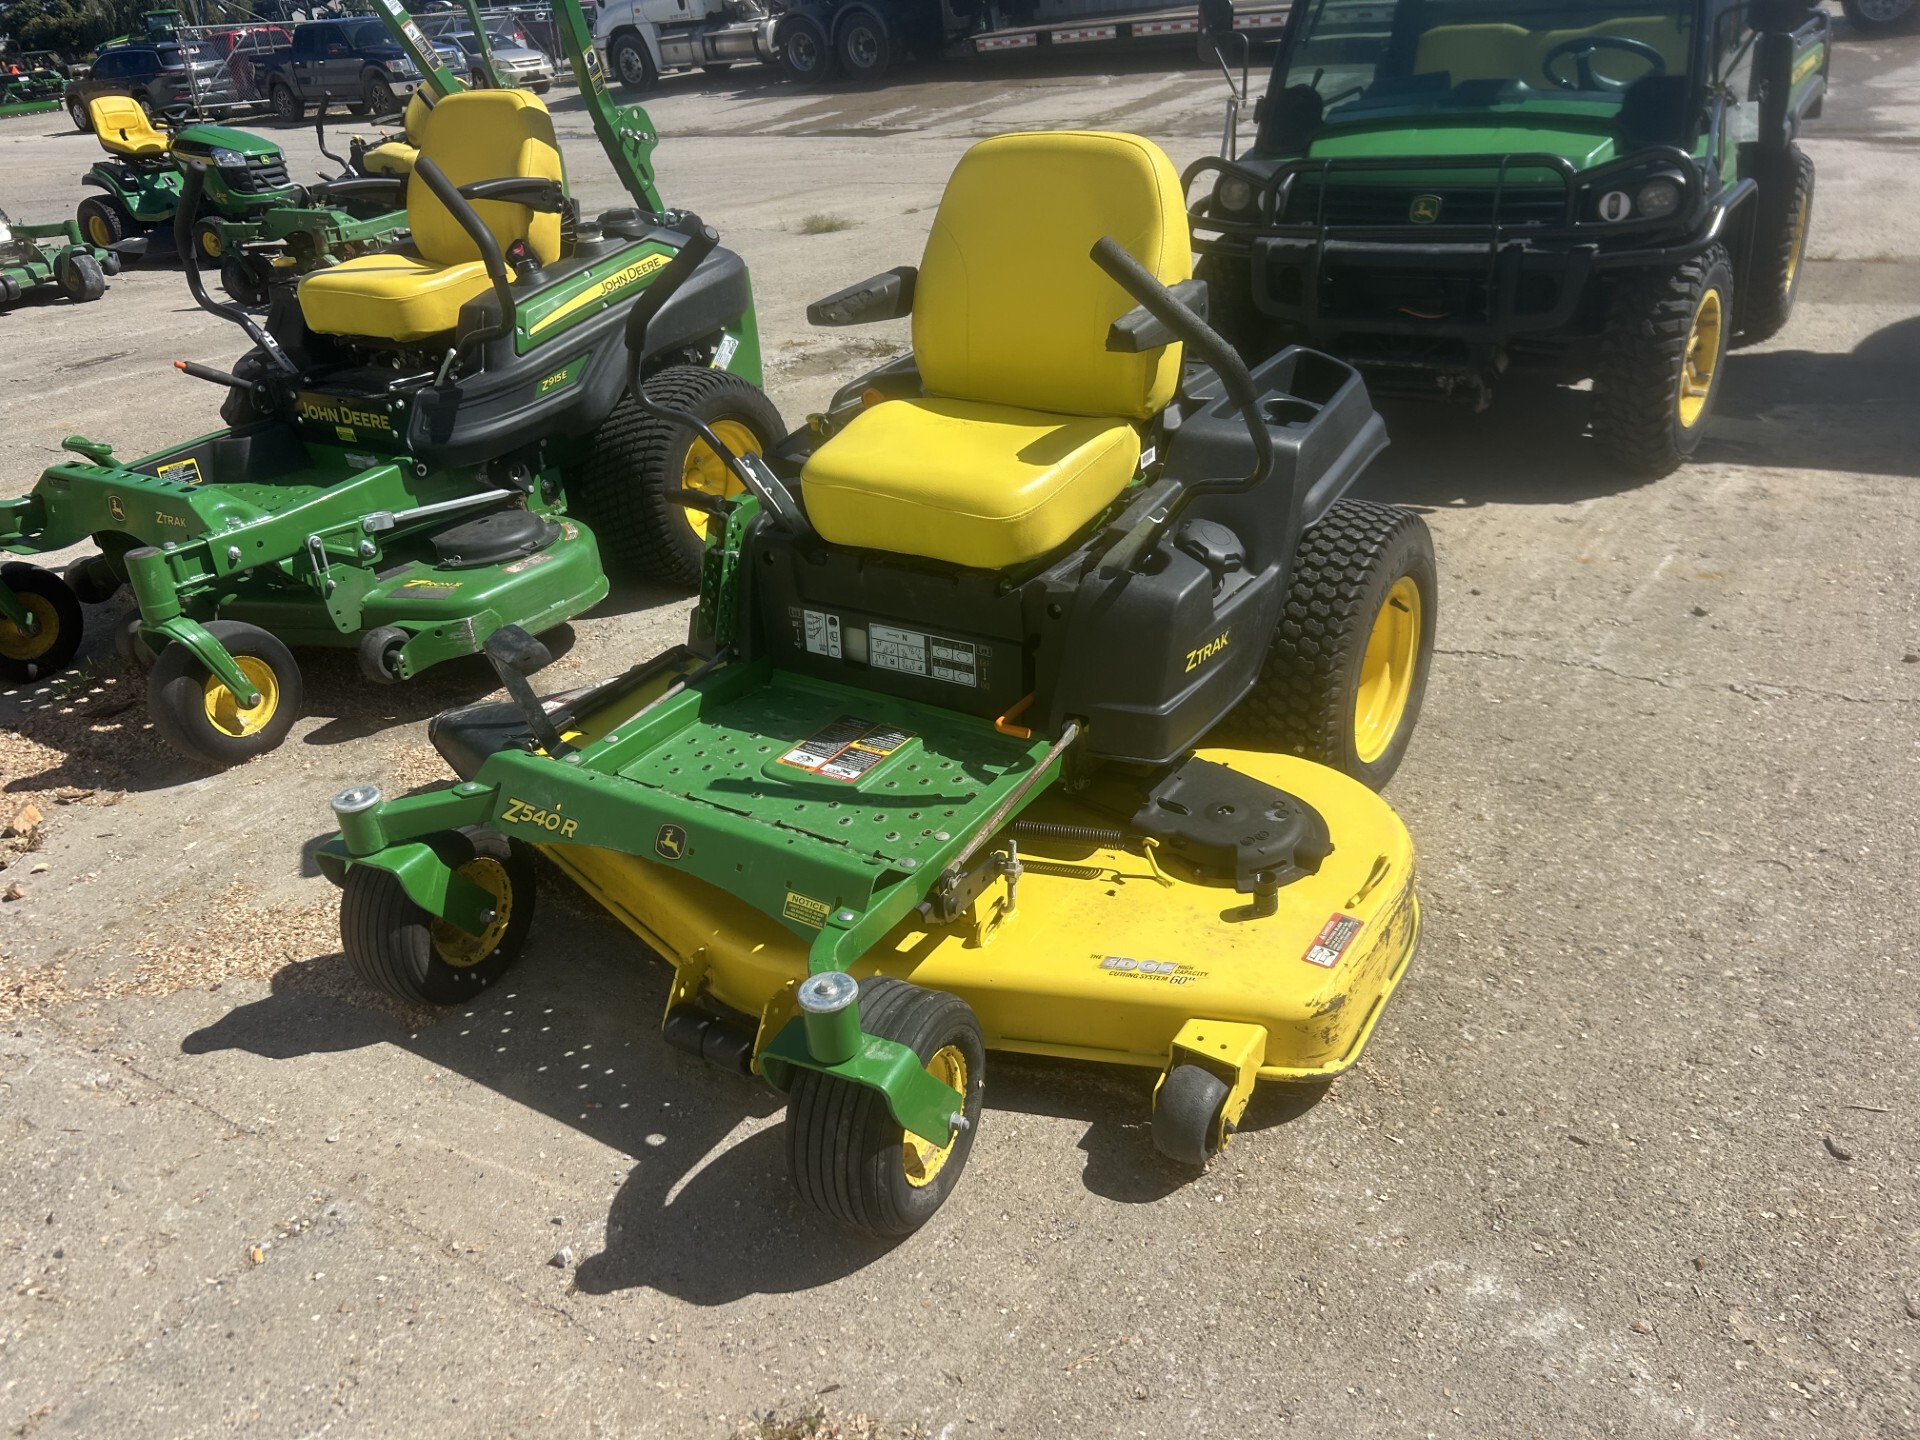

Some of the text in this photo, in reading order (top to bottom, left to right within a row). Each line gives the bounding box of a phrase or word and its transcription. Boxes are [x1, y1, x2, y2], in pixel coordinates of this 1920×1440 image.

[600, 257, 661, 295] JOHN DEERE
[542, 370, 568, 391] Z915E
[302, 402, 391, 430] JOHN DEERE
[156, 511, 187, 528] ZTRAK
[1185, 630, 1230, 673] ZTRAK
[792, 895, 826, 912] NOTICE
[1099, 956, 1178, 976] EDGE
[1109, 970, 1140, 979] CUTTING
[1139, 973, 1169, 982] SYSTEM
[1174, 969, 1209, 977] CAPACITY
